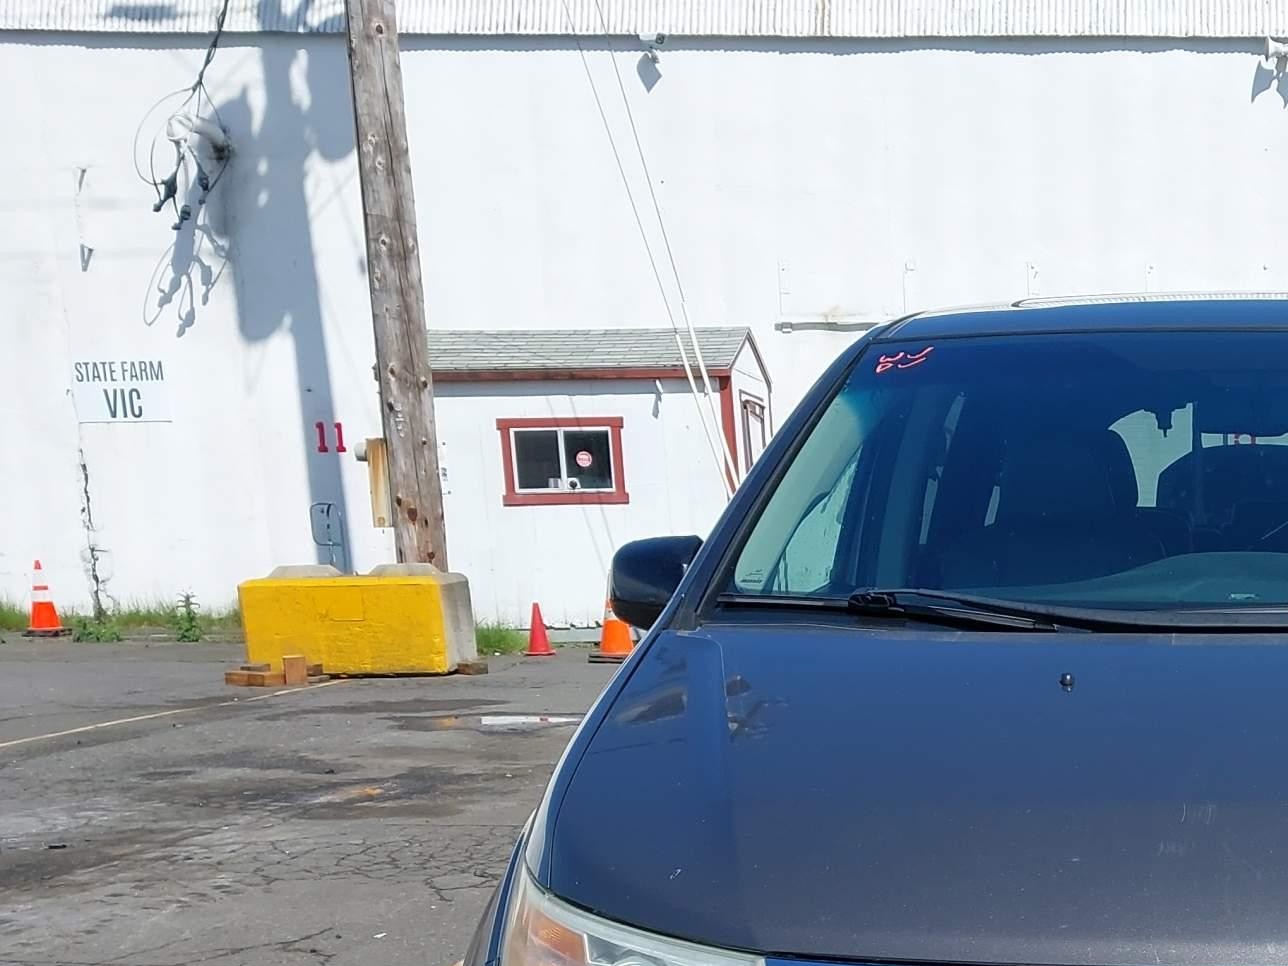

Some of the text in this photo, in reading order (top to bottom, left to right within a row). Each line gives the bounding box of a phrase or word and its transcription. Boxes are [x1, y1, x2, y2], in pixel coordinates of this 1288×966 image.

[74, 360, 164, 383] STATE FARM
[103, 387, 143, 419] VIC
[314, 421, 347, 453] 11
